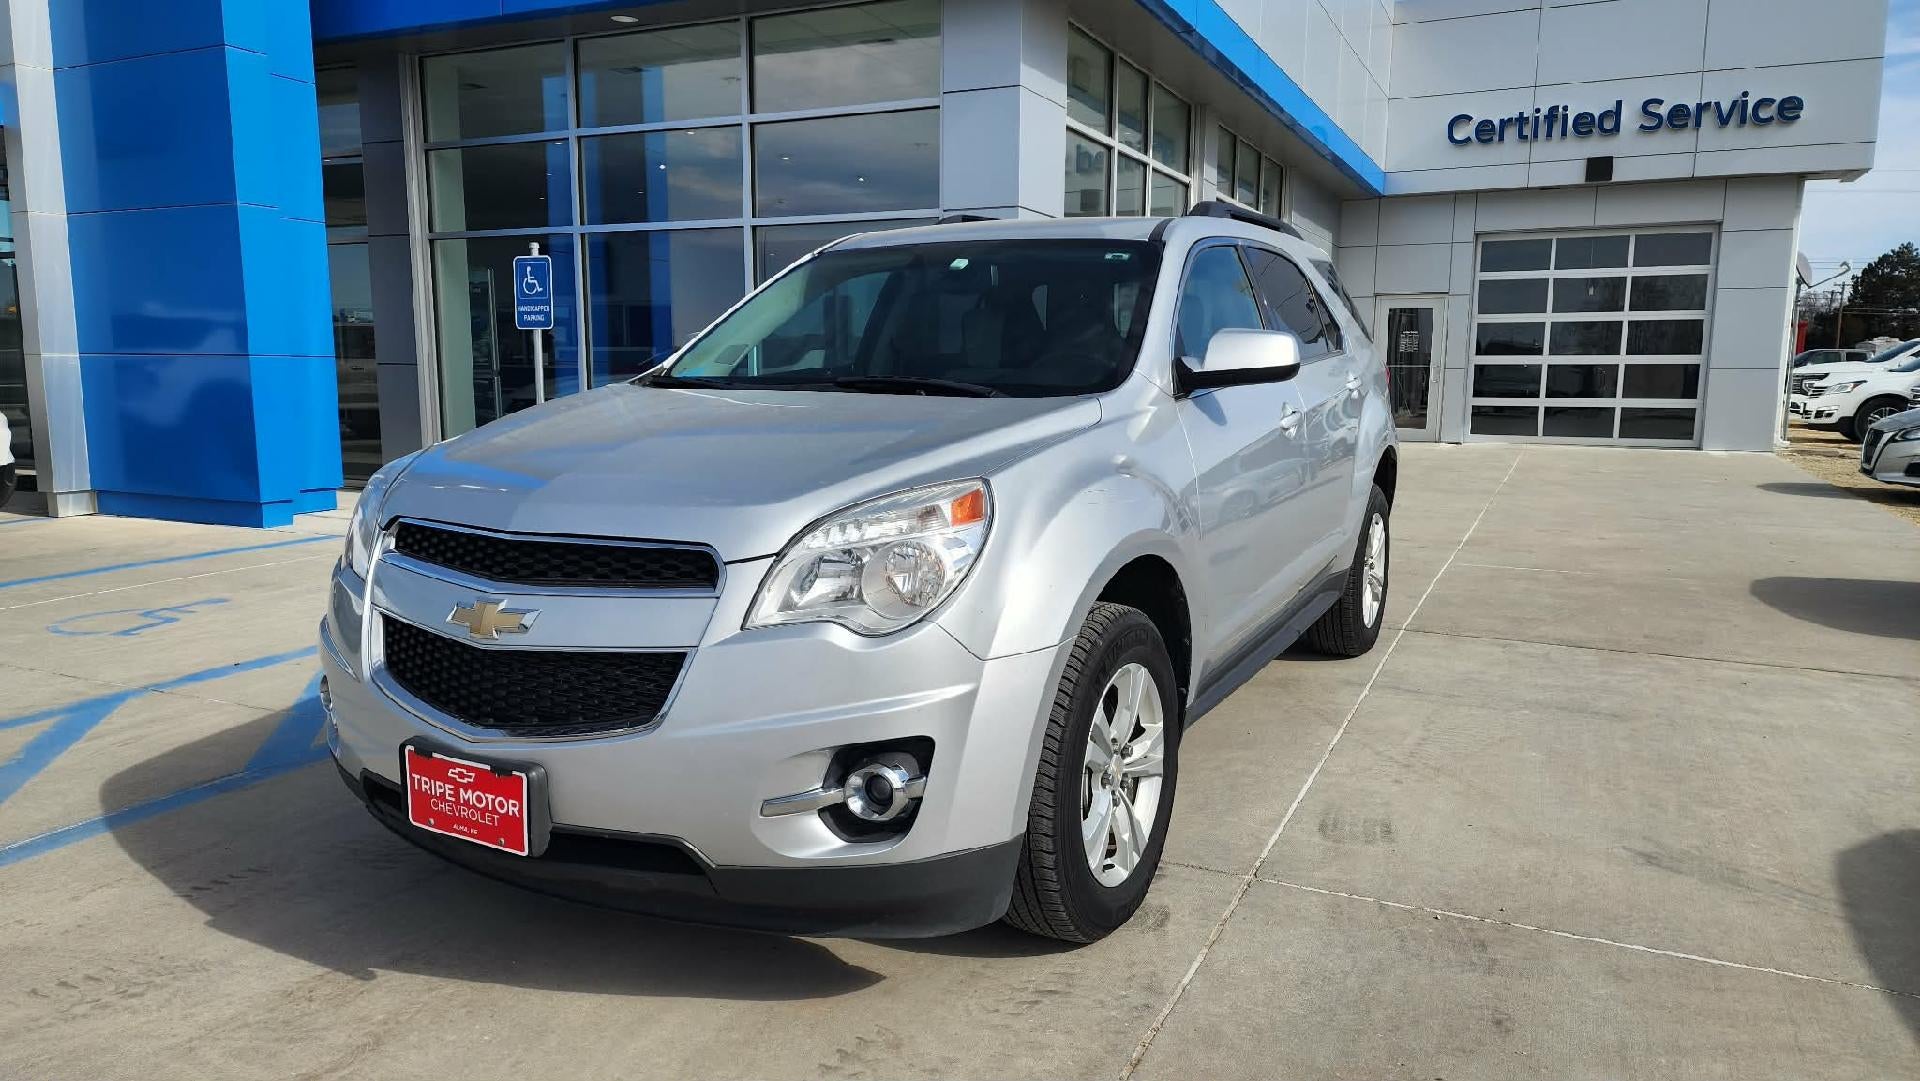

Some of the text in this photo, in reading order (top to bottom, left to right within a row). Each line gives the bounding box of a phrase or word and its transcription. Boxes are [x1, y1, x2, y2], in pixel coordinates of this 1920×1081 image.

[1447, 90, 1804, 145] Certified Service
[412, 773, 520, 817] TRIPE MOTOR
[430, 798, 500, 827] CHEVROLET
